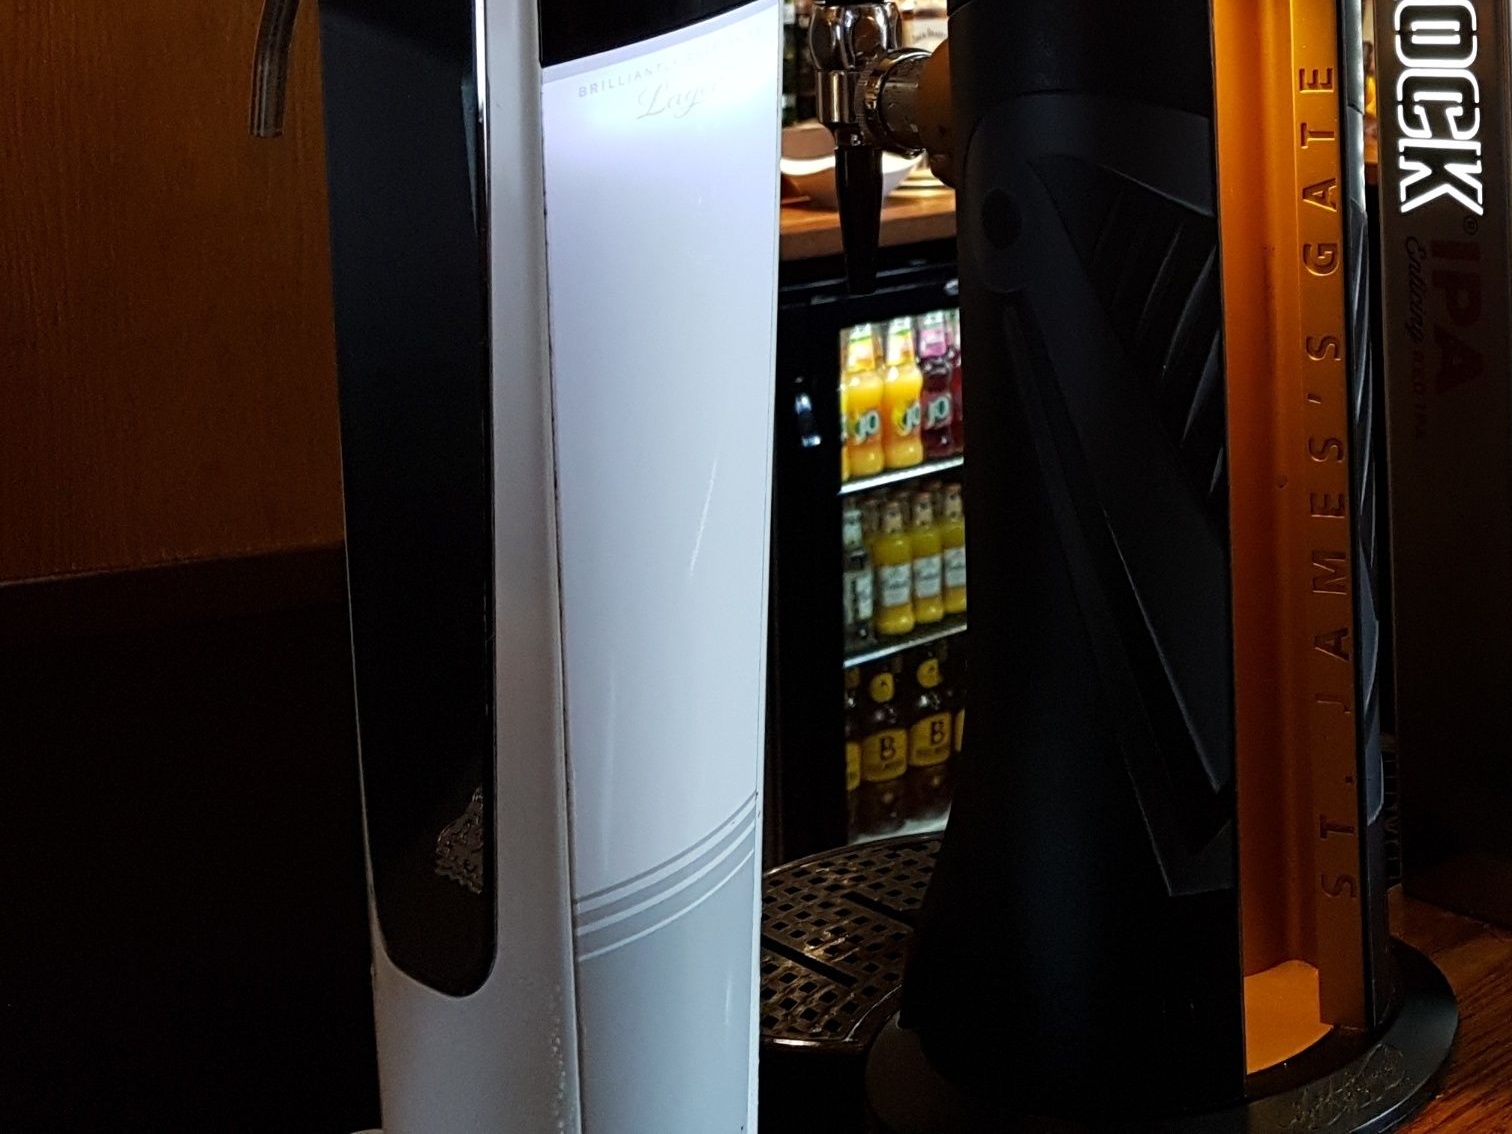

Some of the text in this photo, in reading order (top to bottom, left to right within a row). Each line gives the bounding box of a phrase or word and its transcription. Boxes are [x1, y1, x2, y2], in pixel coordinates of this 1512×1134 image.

[1298, 67, 1358, 900] ST. JAMES'S GATE
